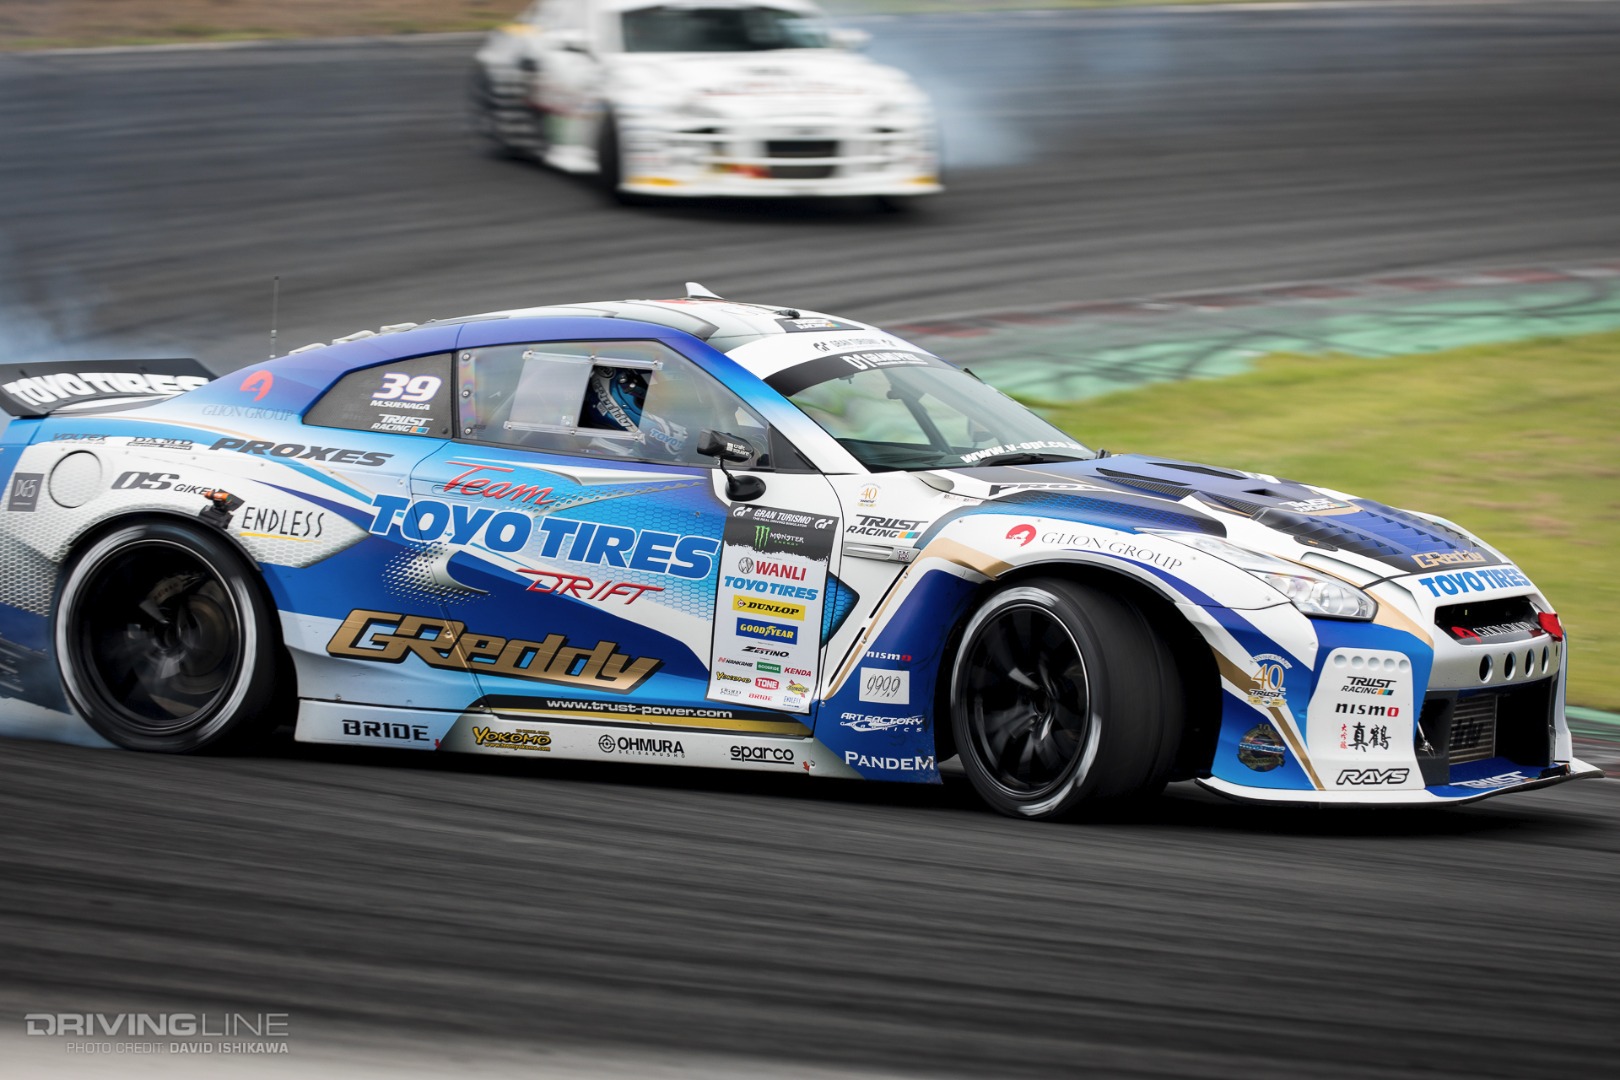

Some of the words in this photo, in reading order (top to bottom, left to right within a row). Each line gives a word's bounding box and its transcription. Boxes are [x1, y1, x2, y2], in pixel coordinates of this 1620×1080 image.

[372, 372, 443, 402] 39
[244, 408, 295, 421] GROUP
[378, 413, 434, 426] TRUST
[371, 422, 412, 432] RACING
[209, 438, 395, 467] PROXES
[111, 471, 179, 490] OS
[444, 461, 557, 505] Team
[861, 487, 878, 500] 40
[241, 506, 326, 539] ENDLESS
[753, 509, 777, 520] GRAN
[777, 512, 811, 525] TURISMO
[856, 514, 929, 530] TRUST
[369, 493, 533, 554] TOYO
[536, 516, 722, 580] TIRES
[770, 532, 804, 544] MONSTER
[846, 525, 900, 538] RACING
[1041, 531, 1108, 549] GLION
[1108, 542, 1183, 570] GROUP
[755, 560, 807, 581] WANLI
[516, 567, 666, 605] DRIFT
[724, 575, 769, 593] TOYO
[769, 582, 819, 601] TIRES
[1418, 571, 1486, 597] TOYO
[1475, 568, 1532, 589] TIRES
[747, 601, 800, 615] DUNLOP
[740, 624, 794, 638] GOODYEAR
[326, 608, 665, 695] GReddy
[742, 645, 790, 658] ZESTINO
[866, 651, 912, 662] nismo
[784, 667, 812, 677] KENDA
[1251, 663, 1284, 691] 40
[757, 679, 779, 690] TONE
[1341, 685, 1378, 695] RACING
[1346, 676, 1397, 688] TRUST
[748, 692, 773, 702] BRIDE
[1250, 689, 1286, 698] TRUST
[546, 700, 733, 719] www.trust-power.com
[1335, 702, 1399, 718] nismo
[342, 719, 430, 741] BRIDE
[472, 726, 552, 745] YOKOMO
[617, 737, 685, 754] OHMURA
[619, 749, 686, 759] SEISAKUSHO
[730, 745, 795, 763] sparco
[844, 750, 935, 771] PANDEM
[1336, 768, 1410, 785] RAYS
